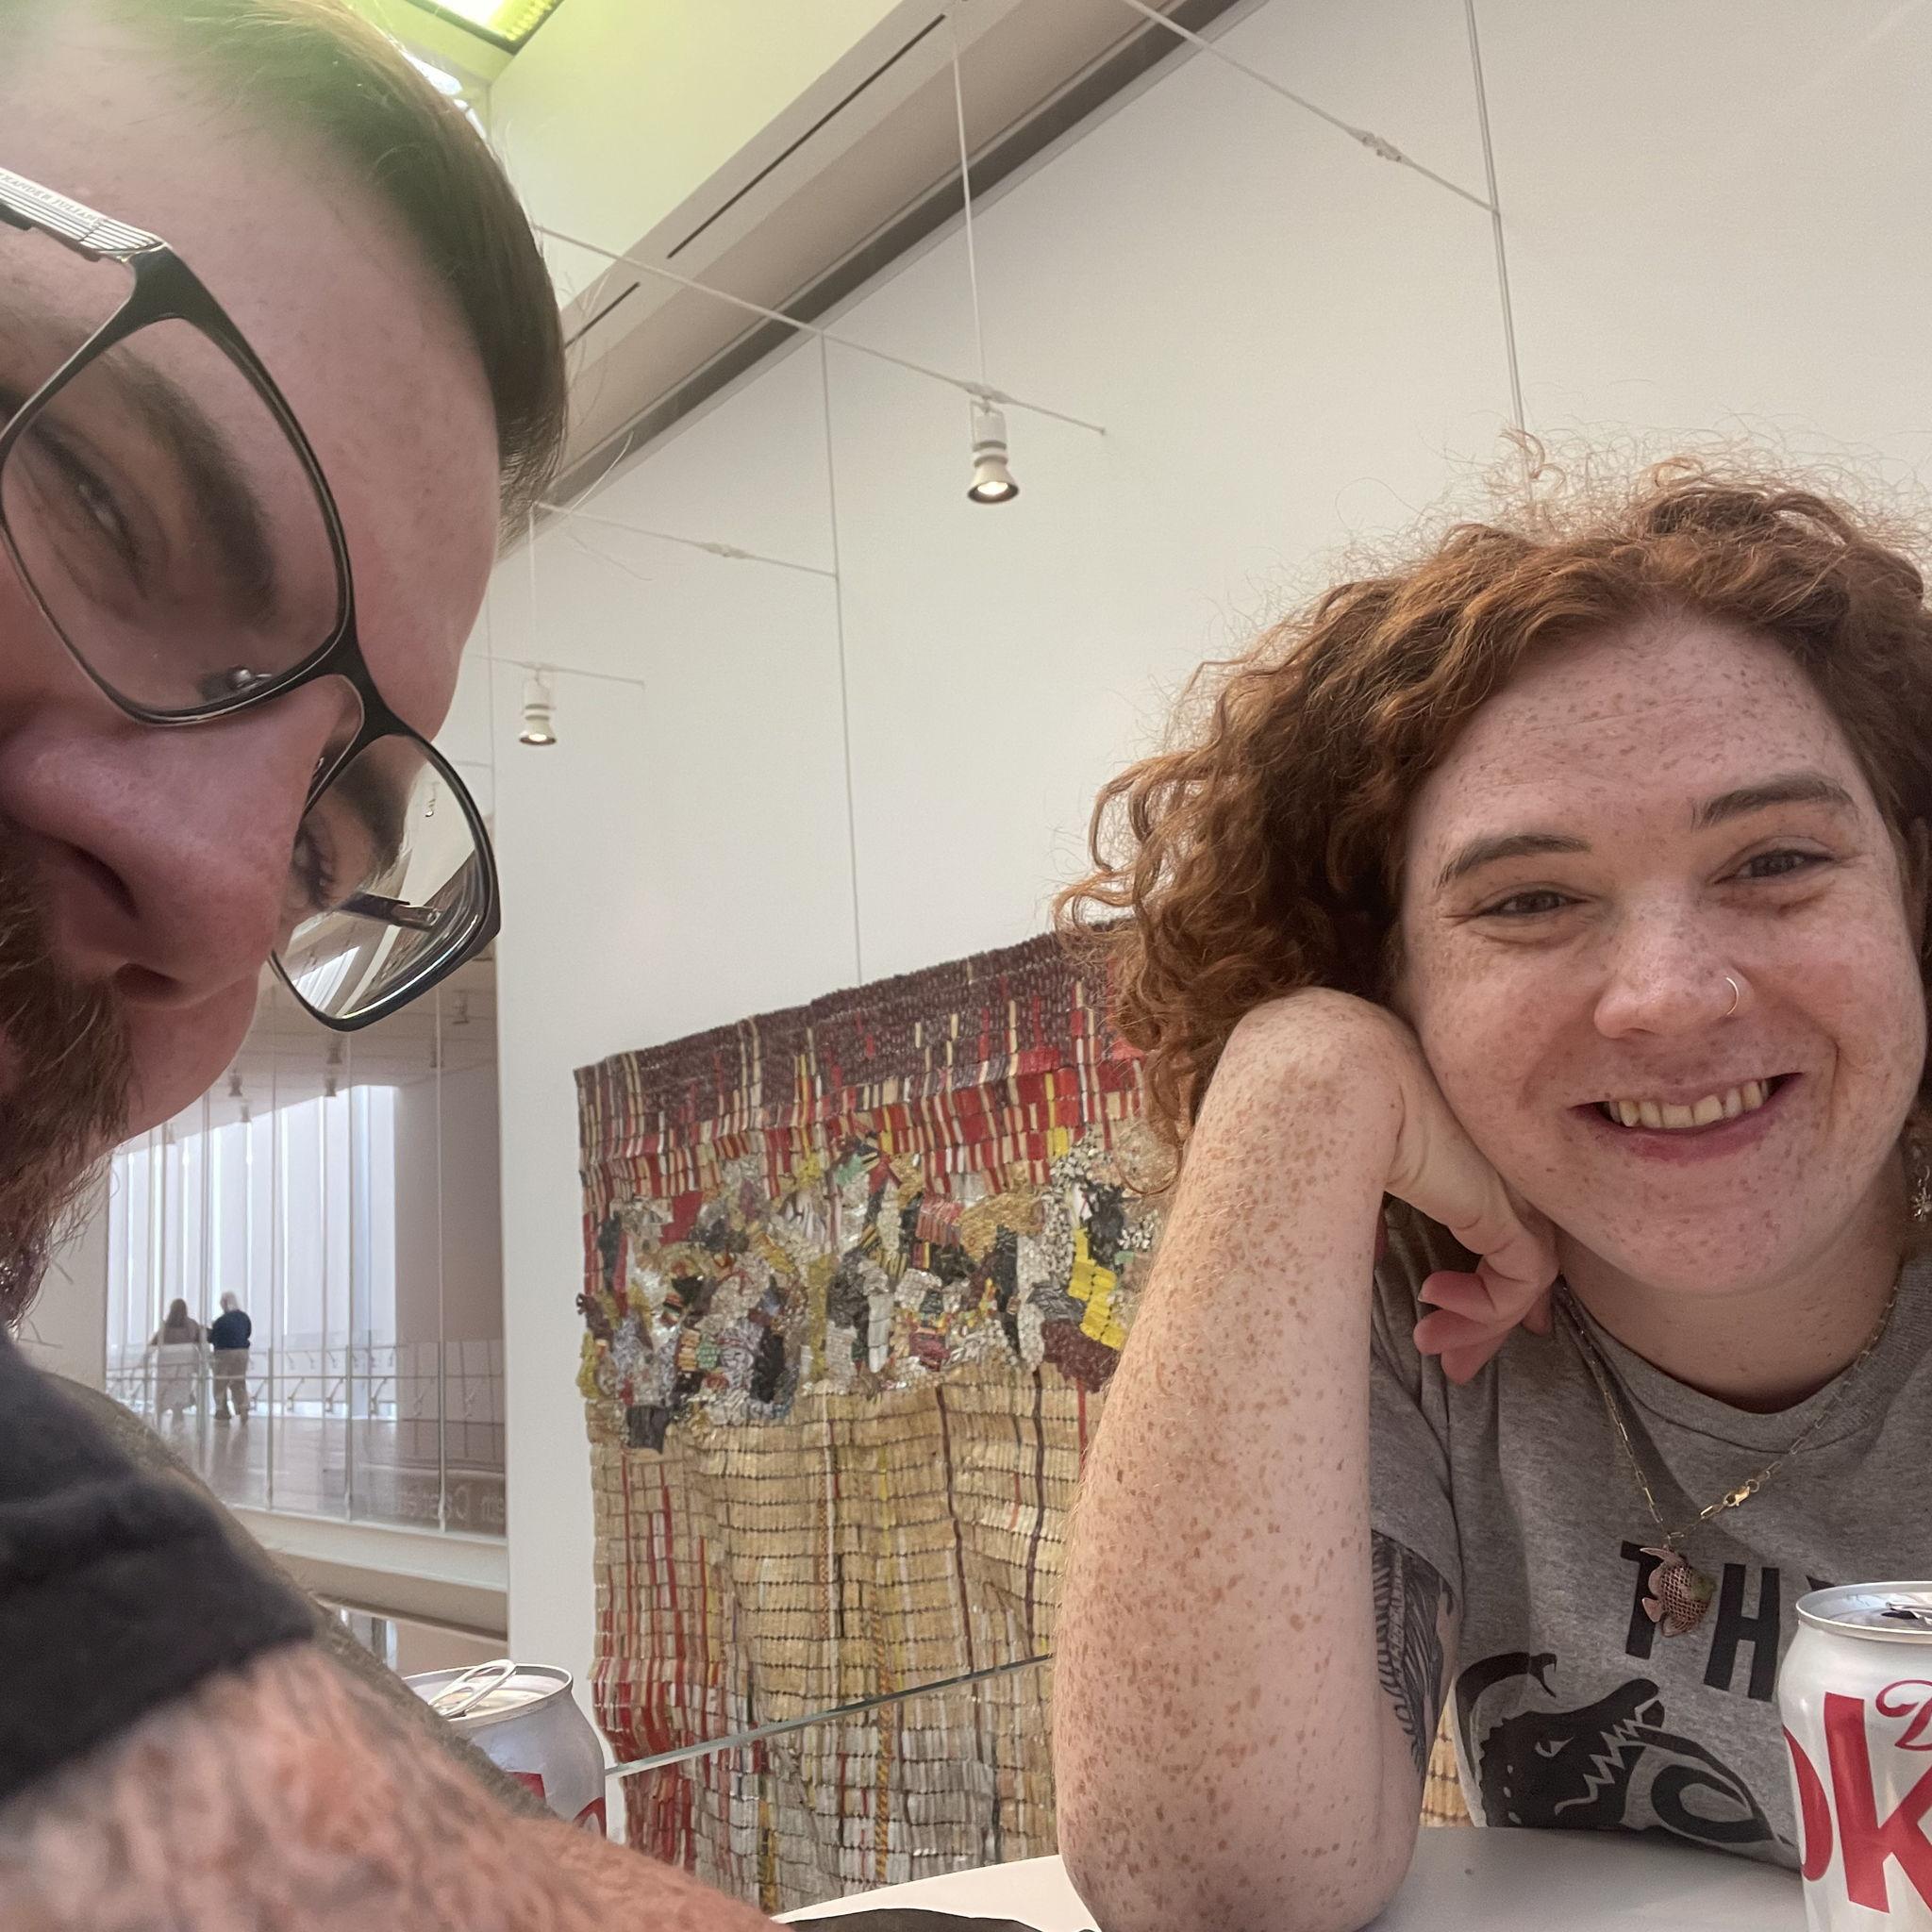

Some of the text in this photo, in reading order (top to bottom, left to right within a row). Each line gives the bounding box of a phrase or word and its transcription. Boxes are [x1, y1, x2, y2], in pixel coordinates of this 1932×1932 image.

[0, 173, 96, 223] XANDER JULIAN
[1621, 1540, 1834, 1703] TH
